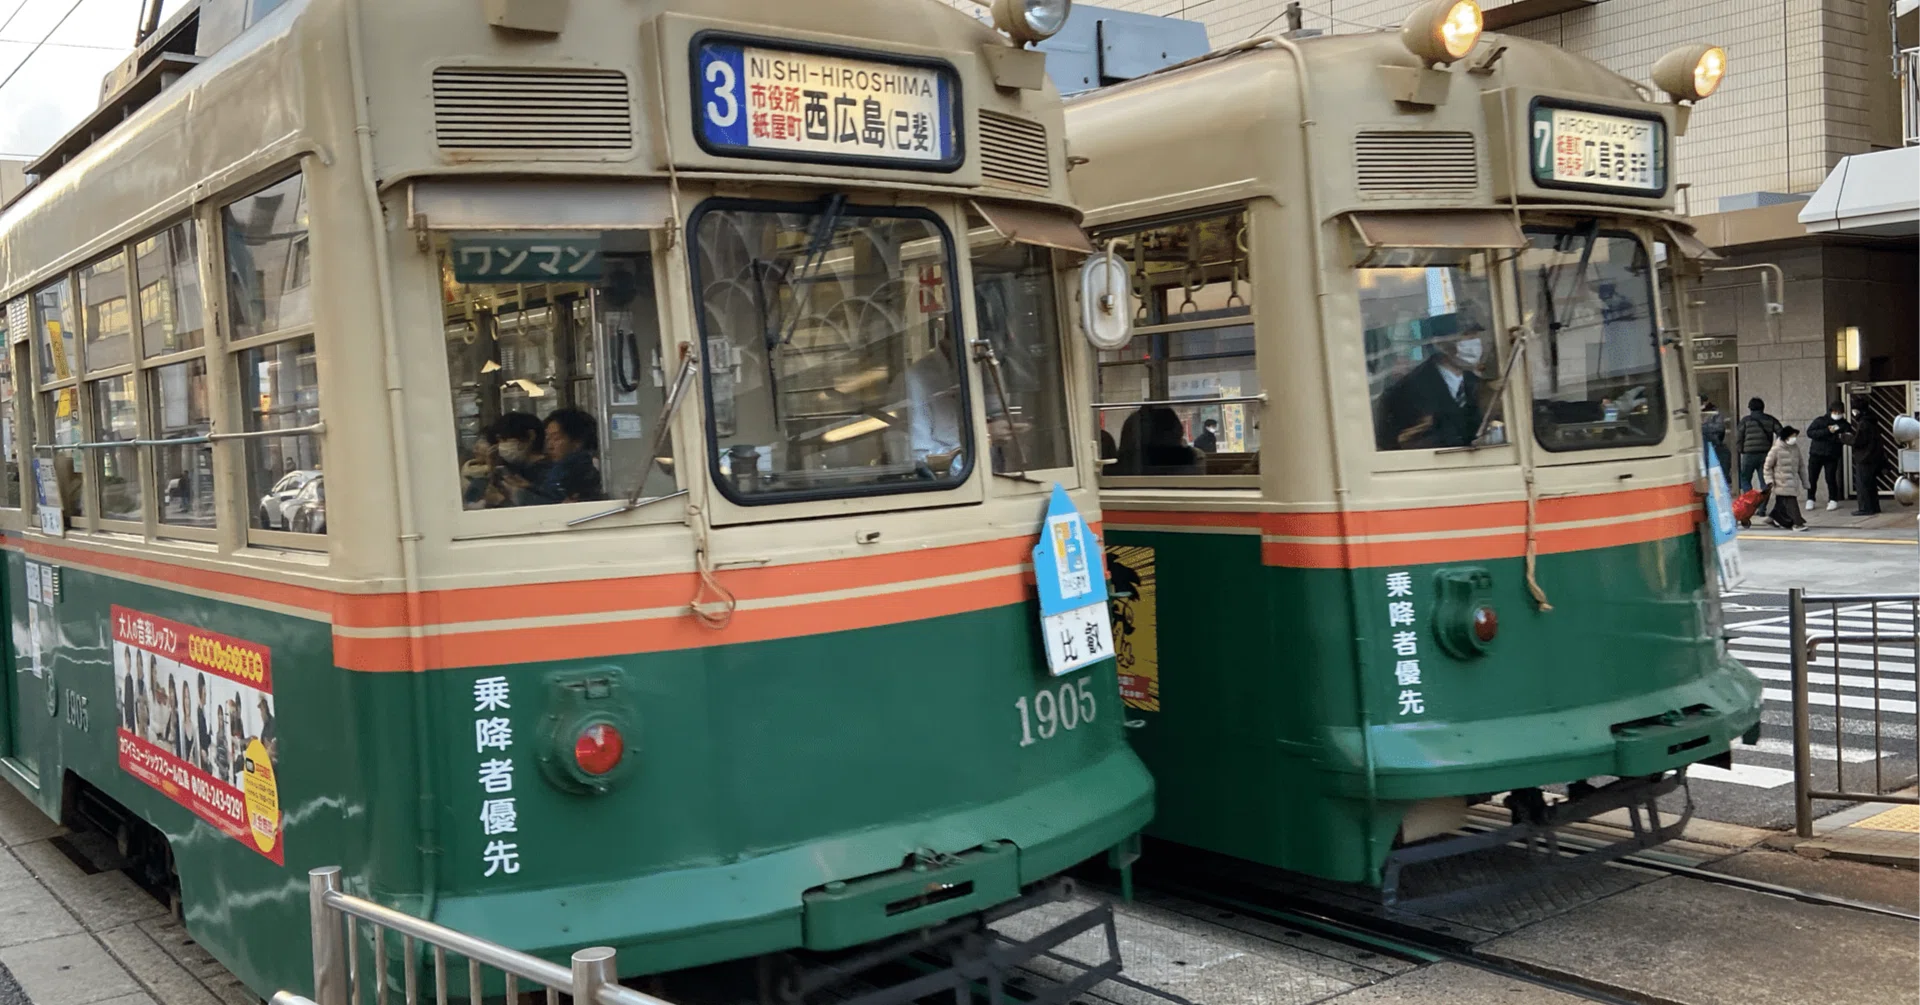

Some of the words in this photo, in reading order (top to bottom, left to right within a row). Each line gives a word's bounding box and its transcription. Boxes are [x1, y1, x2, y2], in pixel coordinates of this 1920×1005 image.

[705, 60, 738, 127] 3
[750, 83, 800, 113] 市役所
[751, 57, 932, 98] NISHI-HIROSHIMA
[752, 111, 802, 142] 紙屋町
[1534, 121, 1551, 168] 7
[461, 245, 597, 275] ワンマン
[118, 612, 178, 654] 大人の音楽レッスン
[1386, 571, 1425, 716] 乗降者優先
[66, 688, 89, 733] 1905
[1015, 676, 1097, 747] 1905
[473, 675, 520, 877] 乗降者優先
